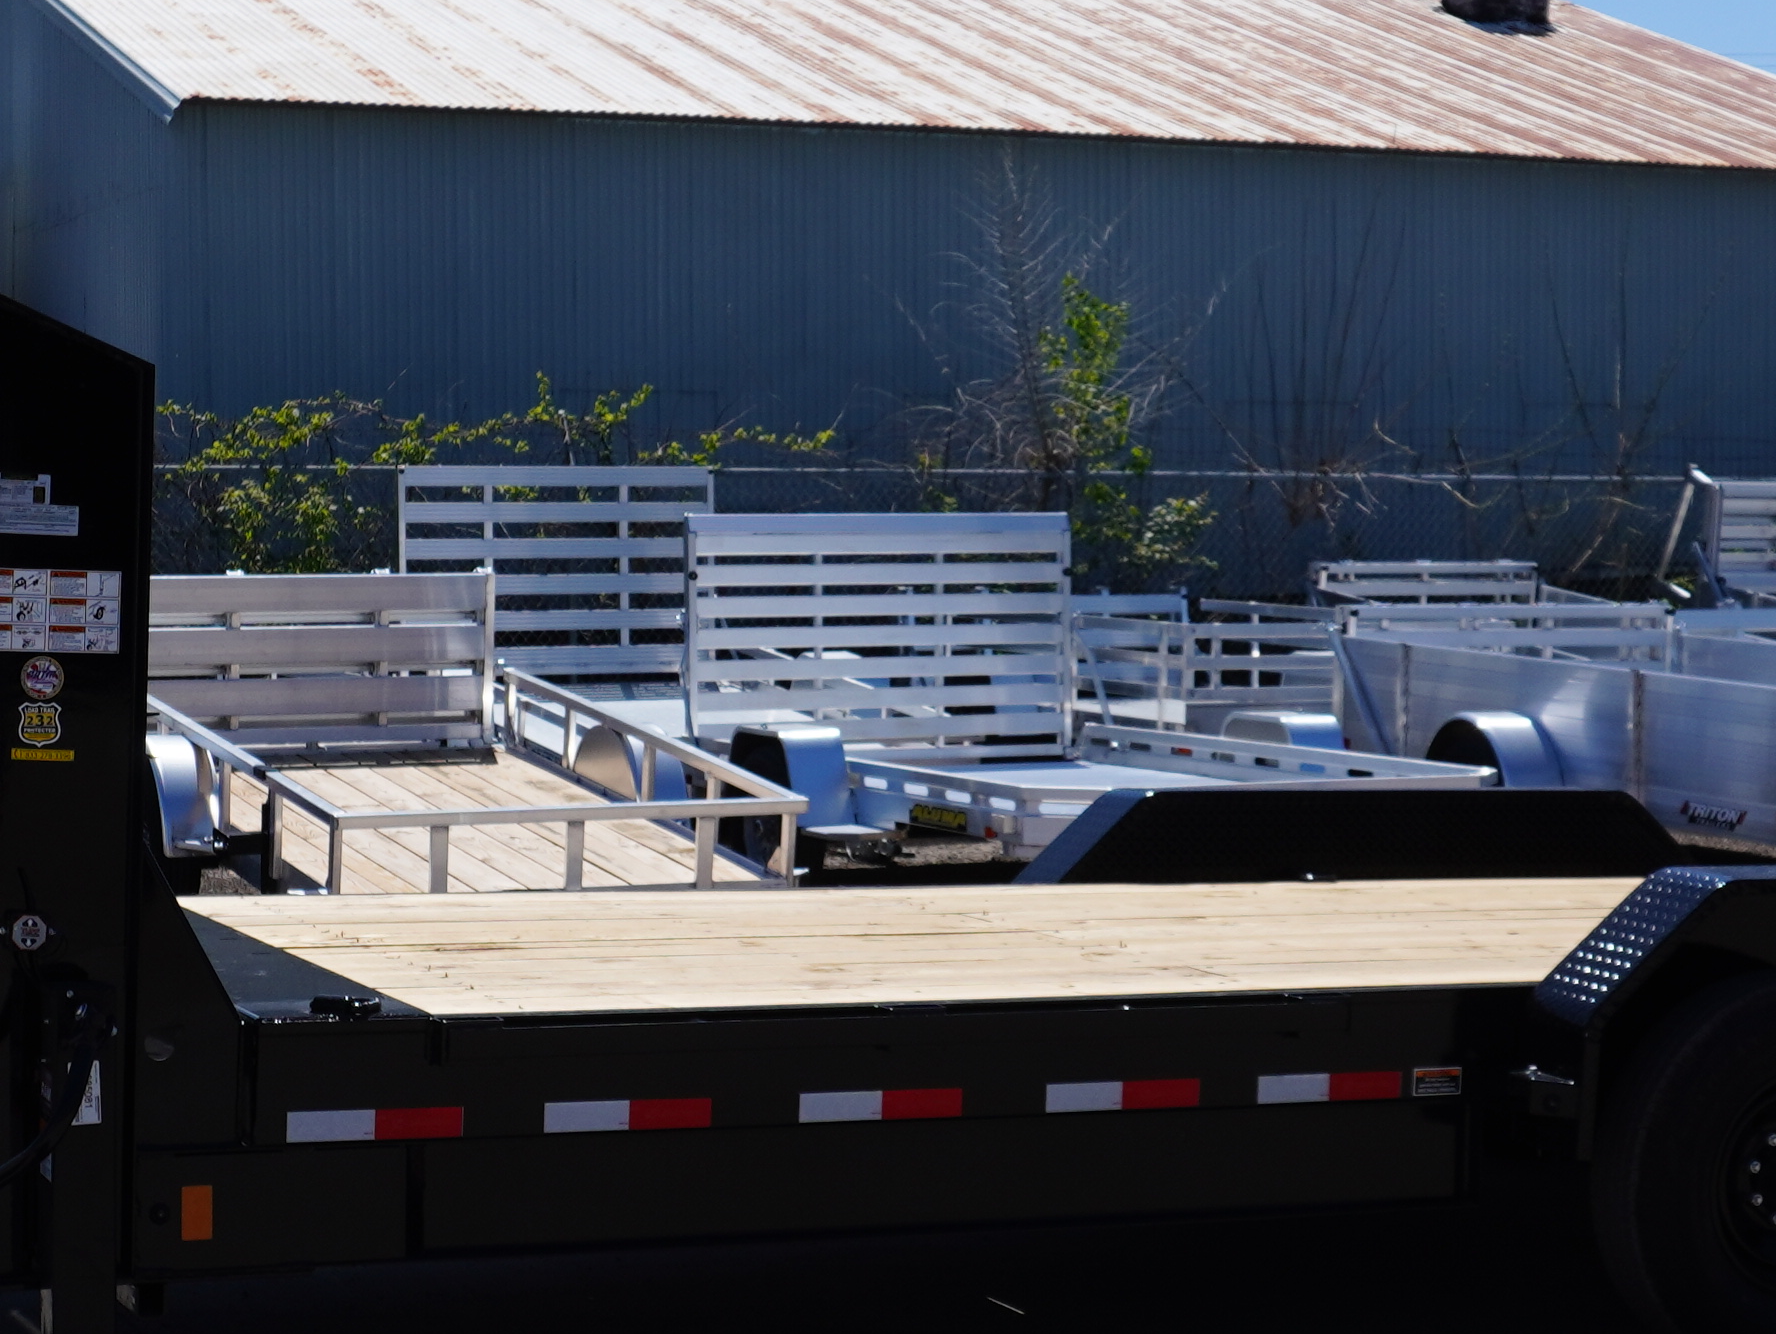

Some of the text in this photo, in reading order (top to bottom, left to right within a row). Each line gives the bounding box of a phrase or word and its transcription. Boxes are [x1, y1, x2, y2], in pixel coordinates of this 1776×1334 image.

[26, 714, 53, 726] 232
[911, 804, 967, 828] ALUMA
[1687, 802, 1742, 824] TRITON
